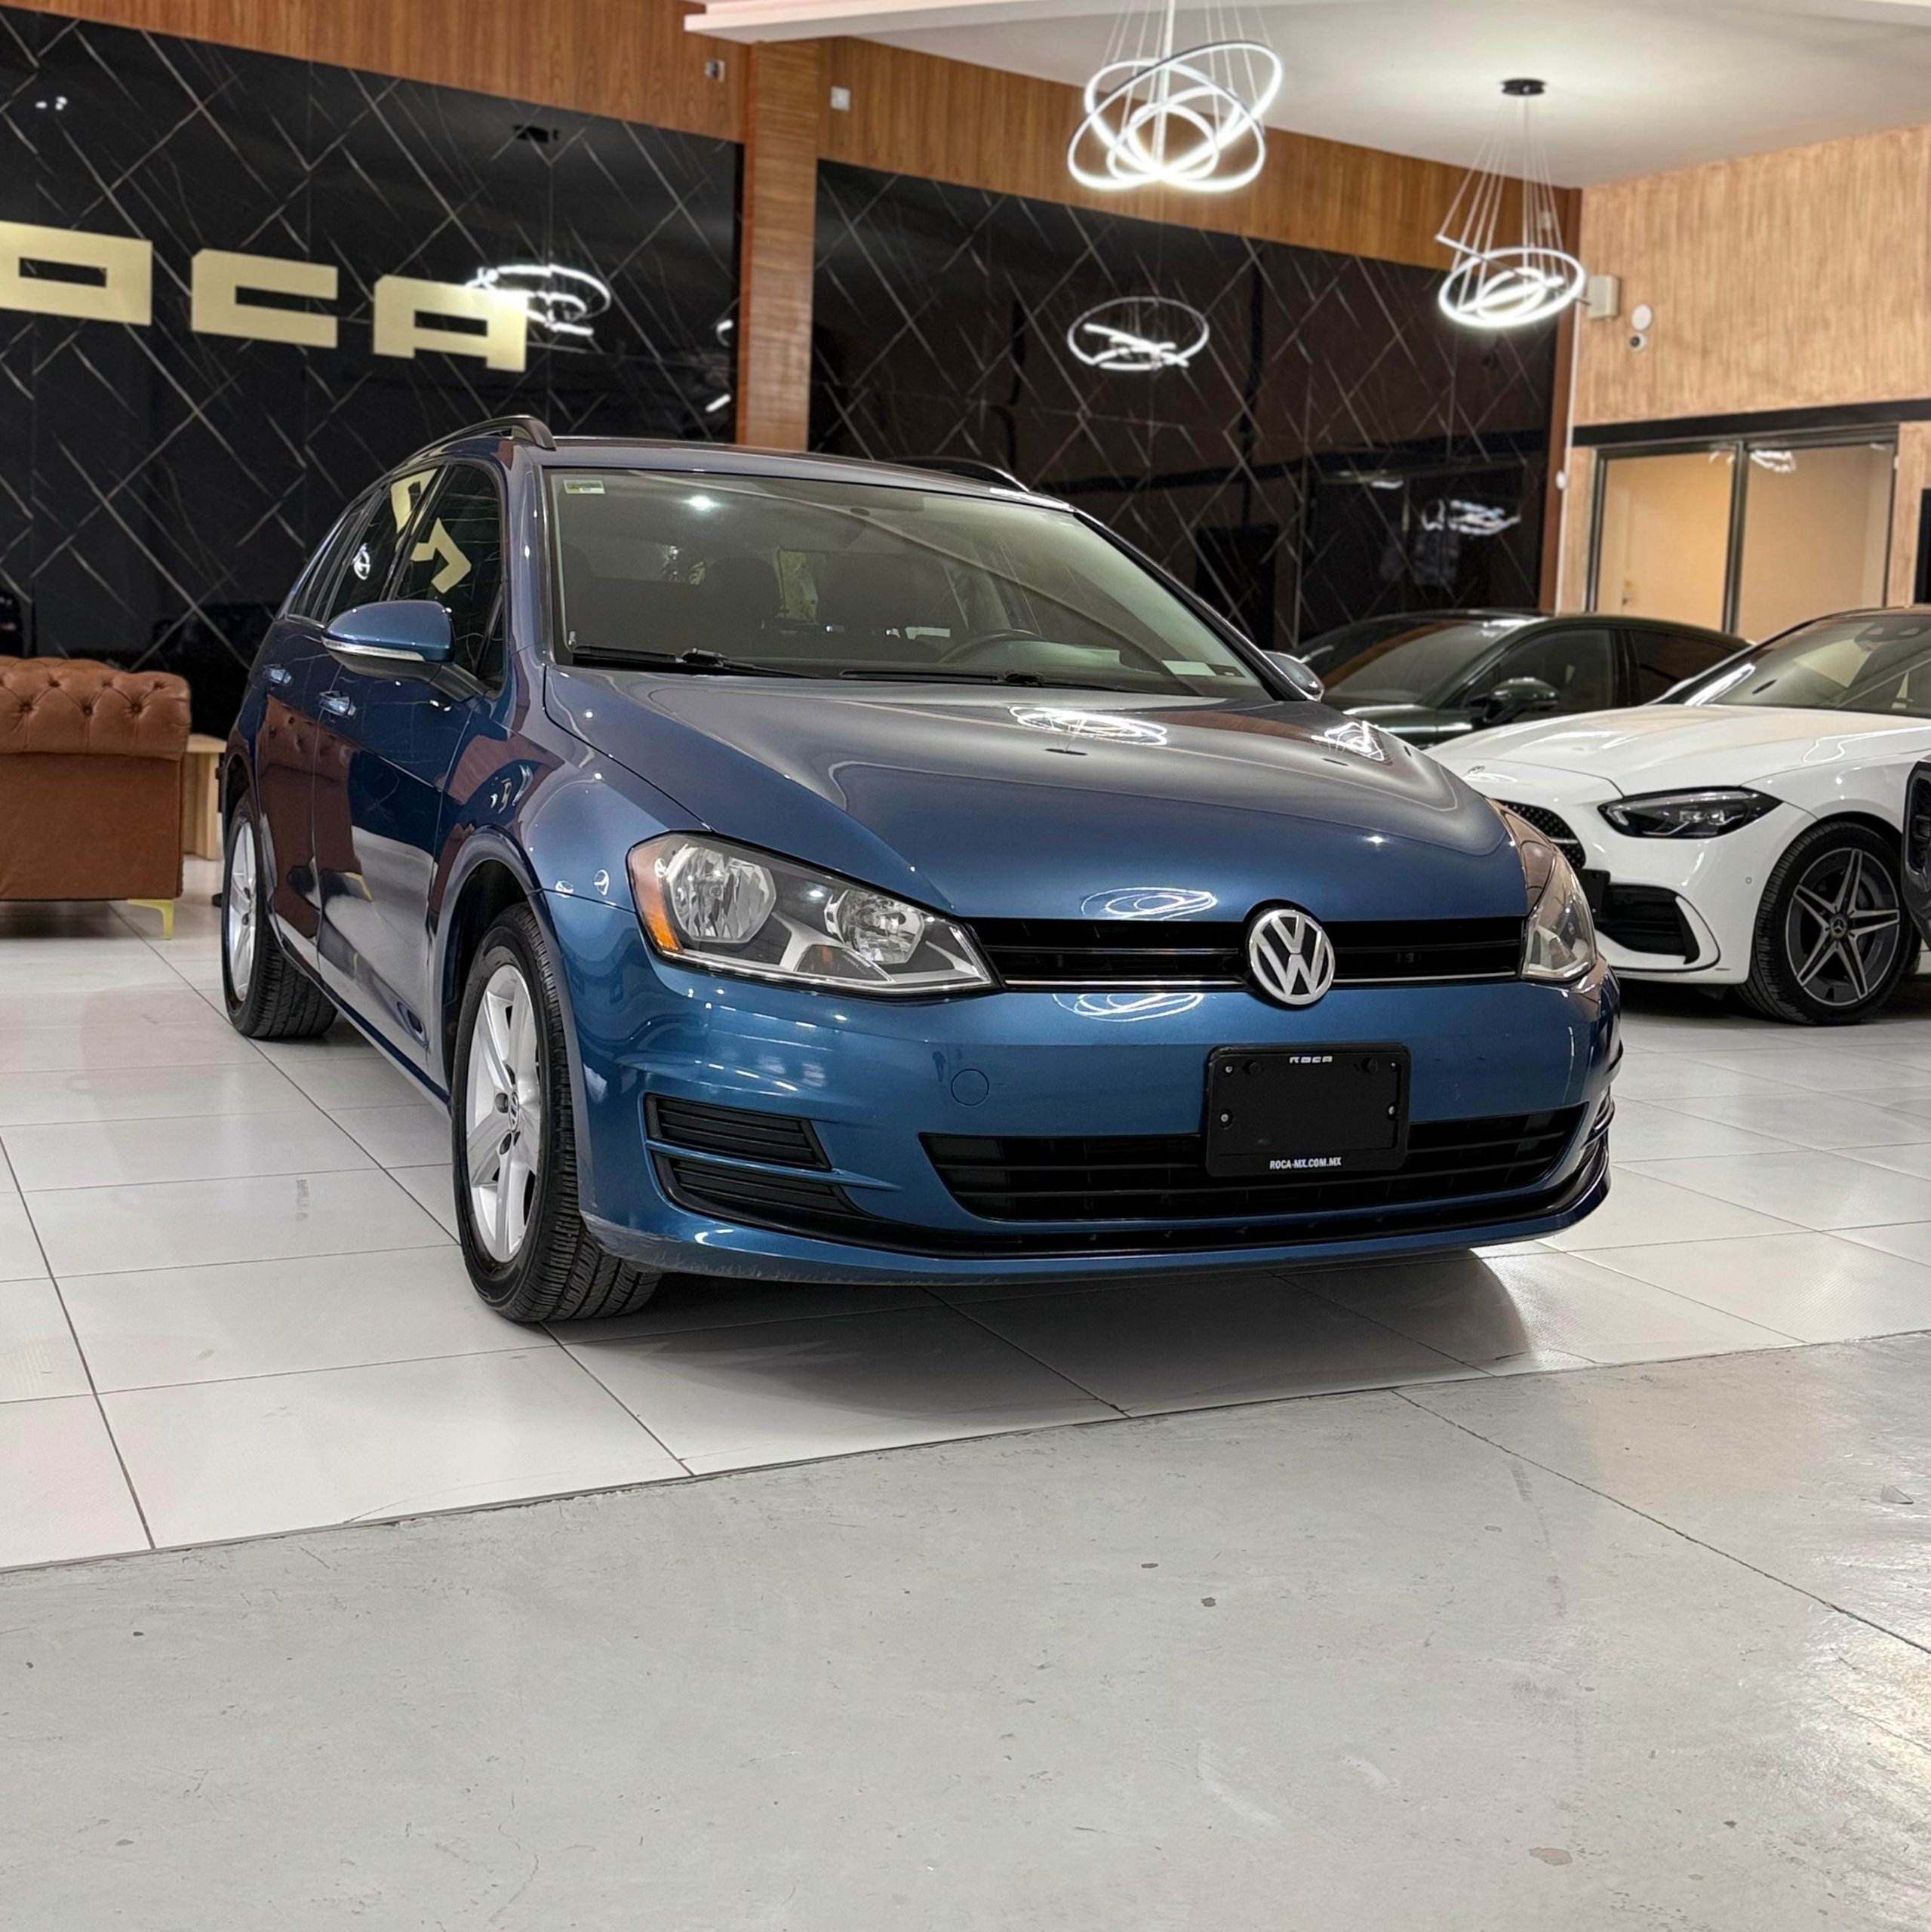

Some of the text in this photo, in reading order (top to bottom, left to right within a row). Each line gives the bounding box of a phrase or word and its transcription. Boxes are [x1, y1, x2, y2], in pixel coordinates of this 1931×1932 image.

[1250, 910, 1333, 1002] VW
[1289, 1055, 1333, 1064] ROCA
[1269, 1156, 1342, 1170] ROCA-MX.COM.MX
